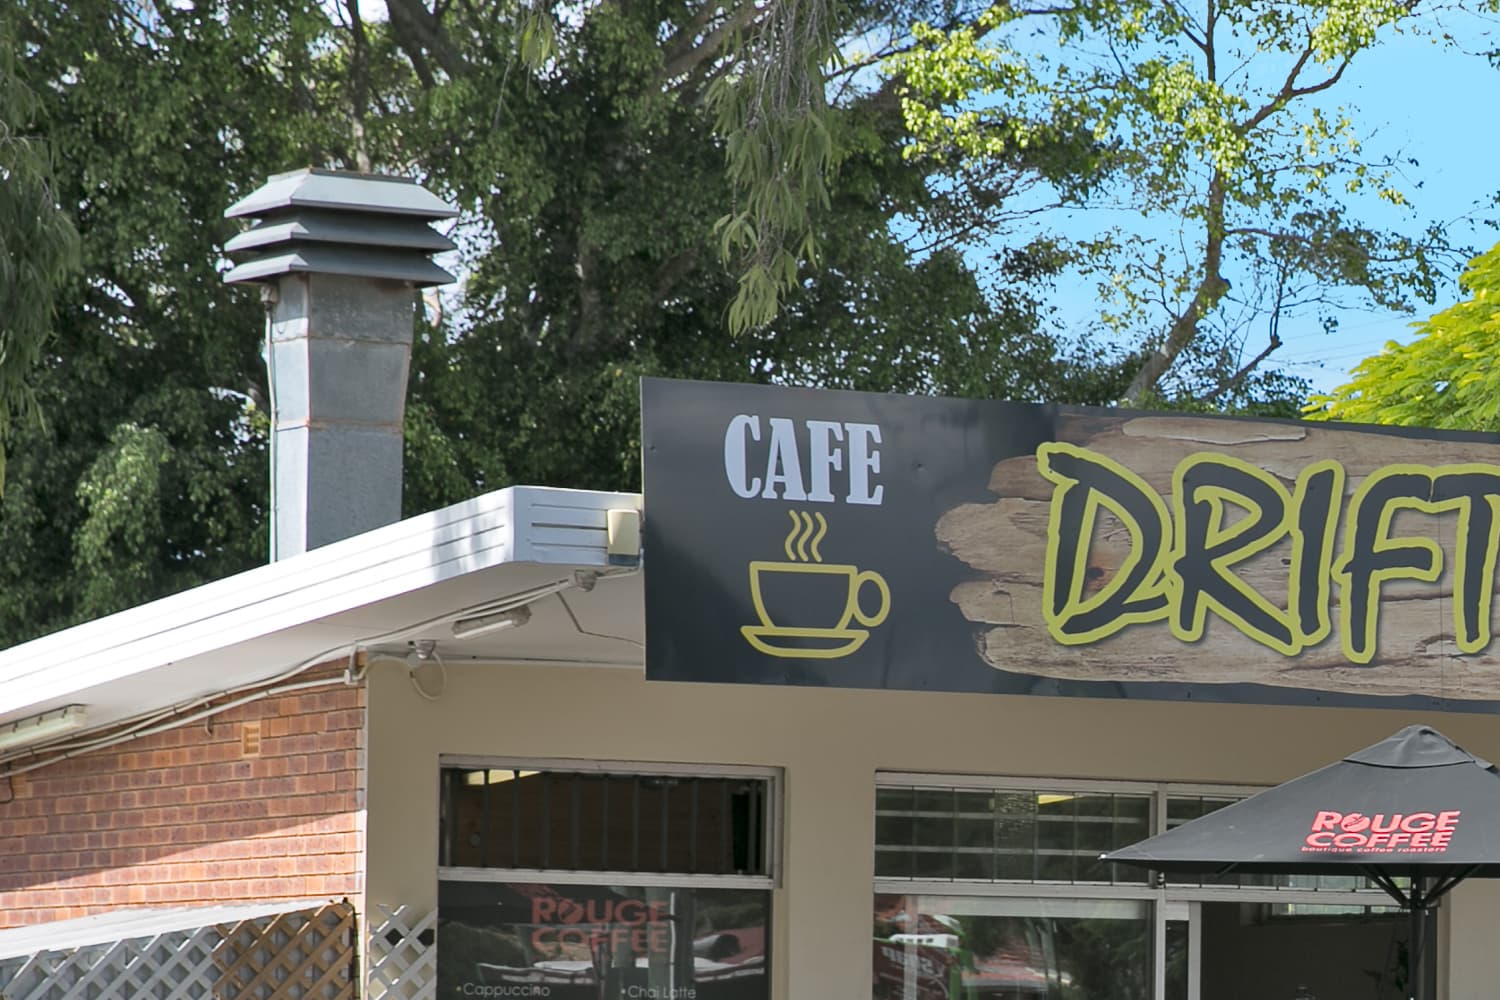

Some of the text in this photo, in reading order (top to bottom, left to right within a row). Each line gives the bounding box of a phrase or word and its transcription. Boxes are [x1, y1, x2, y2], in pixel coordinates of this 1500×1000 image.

[724, 414, 884, 505] CAFE
[1311, 810, 1461, 833] ROUGE
[1305, 831, 1454, 848] COFFEE
[531, 898, 671, 926] ROUGE
[531, 928, 670, 954] COFFEE
[463, 983, 551, 998] Cappuccino
[627, 985, 697, 999] Chai Latte
